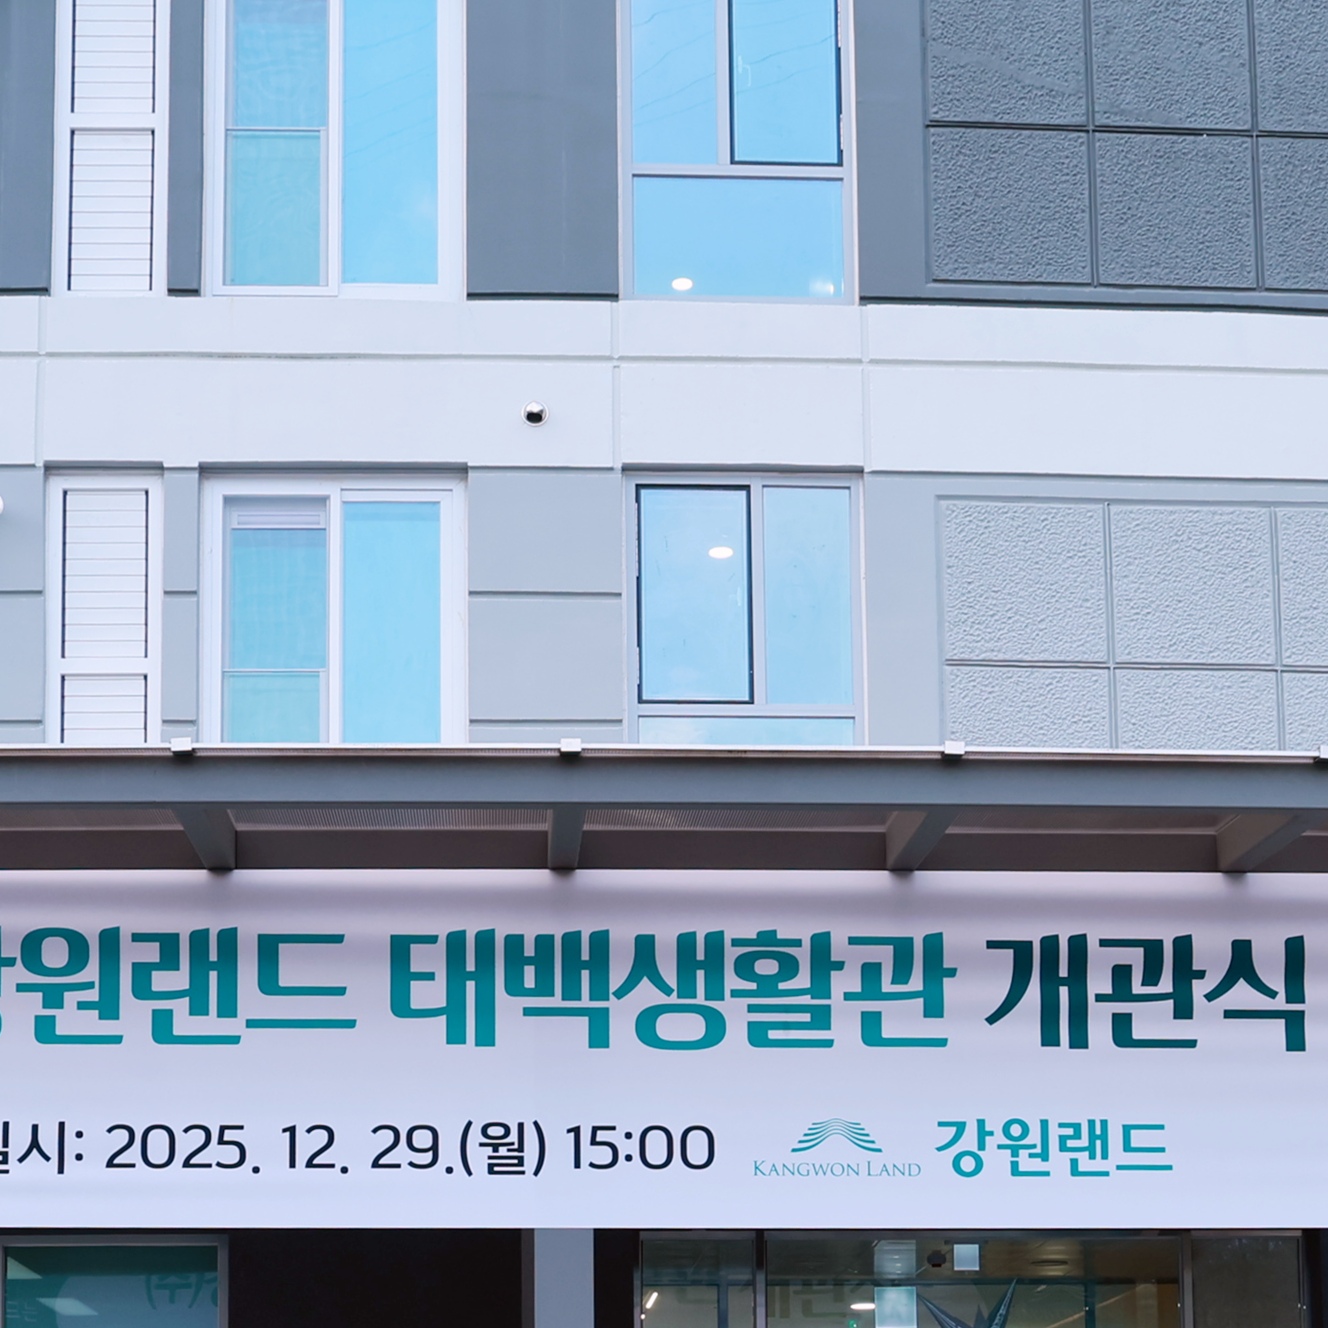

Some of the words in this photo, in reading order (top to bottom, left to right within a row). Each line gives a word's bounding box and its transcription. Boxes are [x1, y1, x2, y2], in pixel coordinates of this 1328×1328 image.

[390, 929, 958, 1050] 태백생활관
[985, 933, 1306, 1052] 개관식
[105, 1124, 260, 1174] 2025.
[282, 1125, 348, 1174] 12.
[371, 1120, 546, 1177] 29.(월)
[566, 1125, 715, 1170] 15:00
[754, 1161, 859, 1176] KANGWON
[868, 1161, 921, 1176] LAND
[935, 1118, 1173, 1178] 강원랜드
